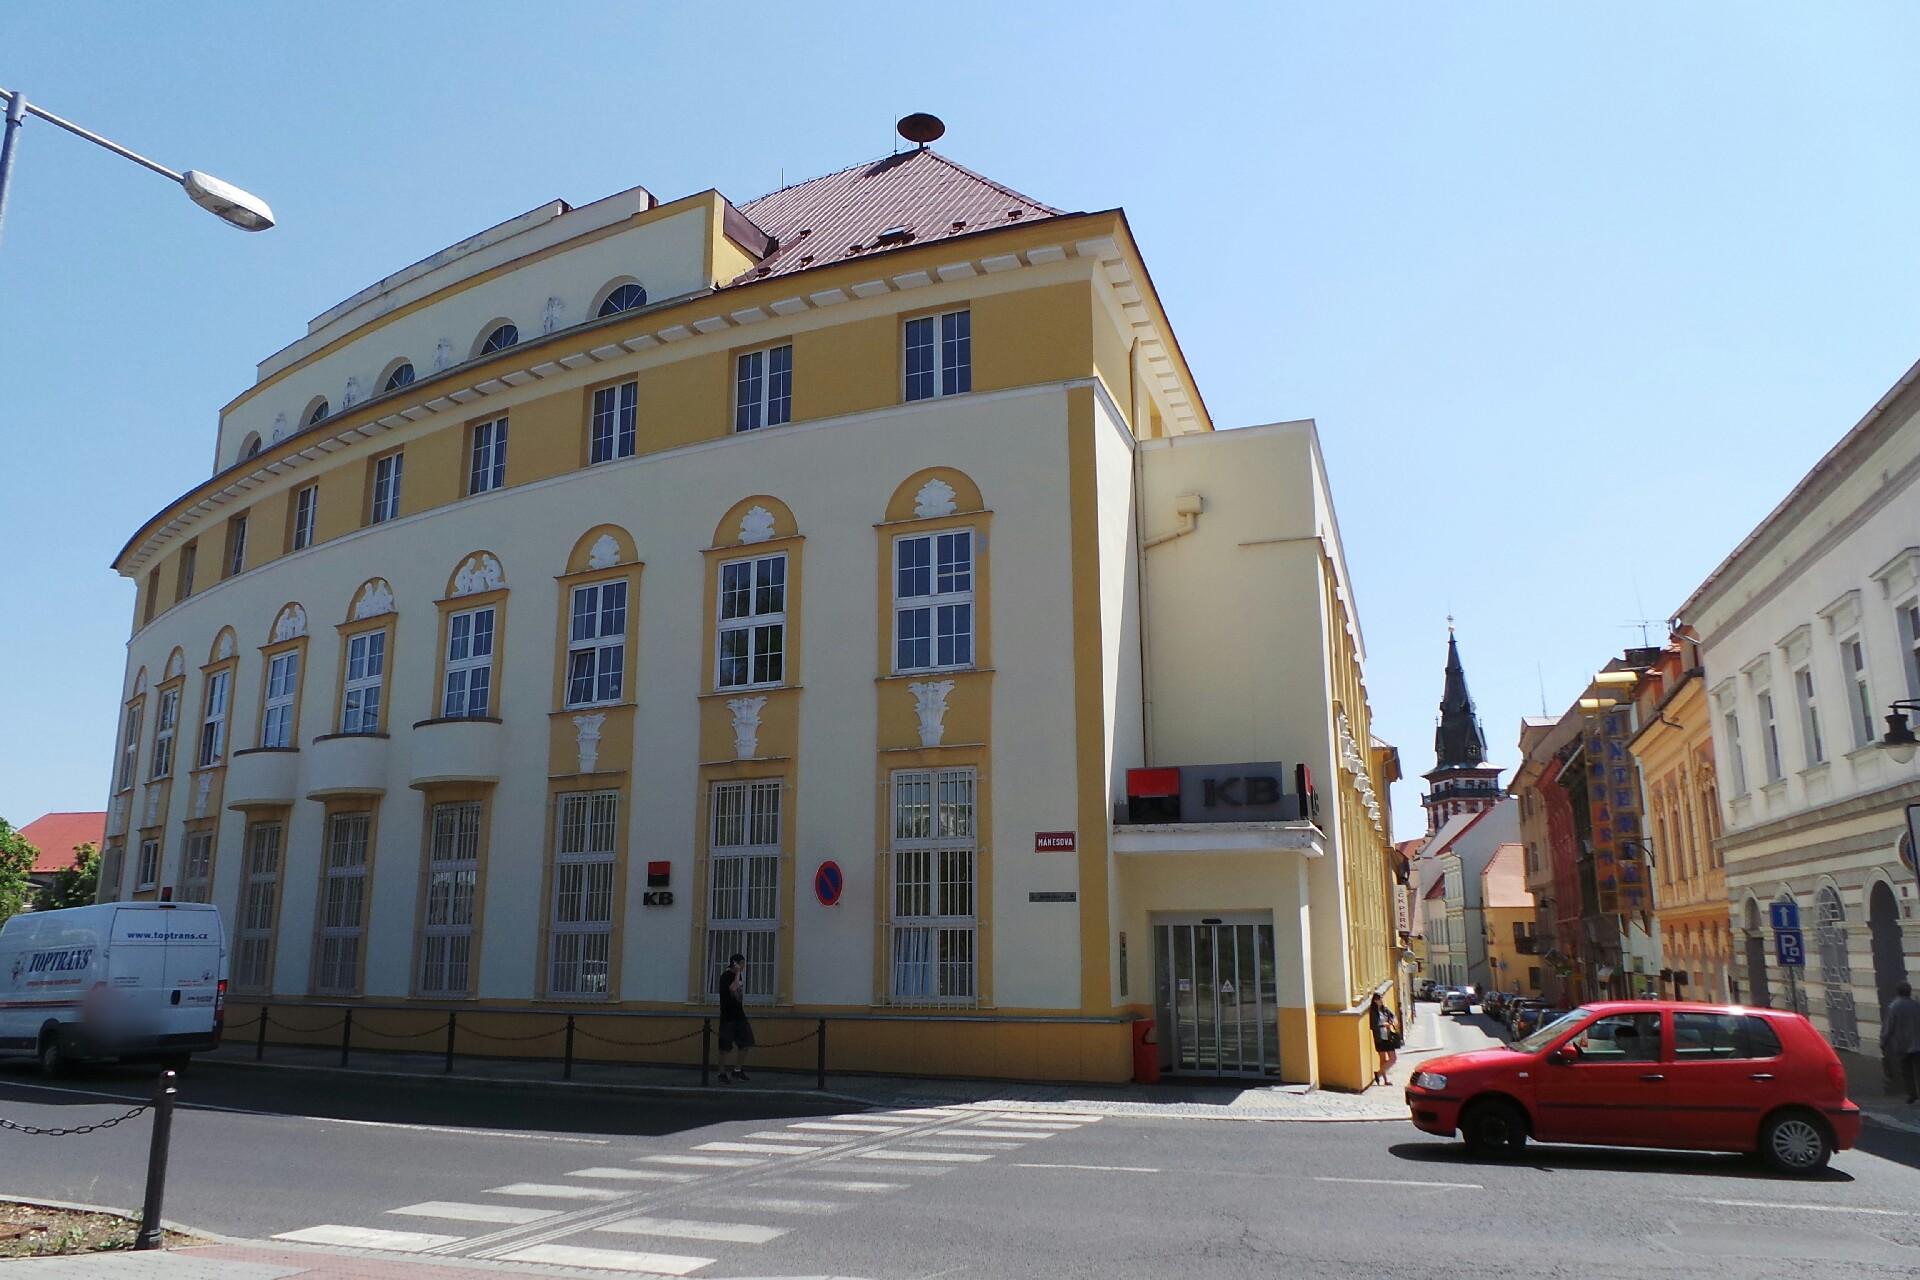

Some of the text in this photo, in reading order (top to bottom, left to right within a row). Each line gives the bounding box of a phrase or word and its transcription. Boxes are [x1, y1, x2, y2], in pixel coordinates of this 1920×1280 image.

[1202, 776, 1280, 807] KB
[1037, 836, 1073, 847] MÁNESOVA
[644, 892, 674, 906] KB
[127, 931, 208, 941] www.toptrans.cz
[28, 949, 93, 973] TOPTRANS
